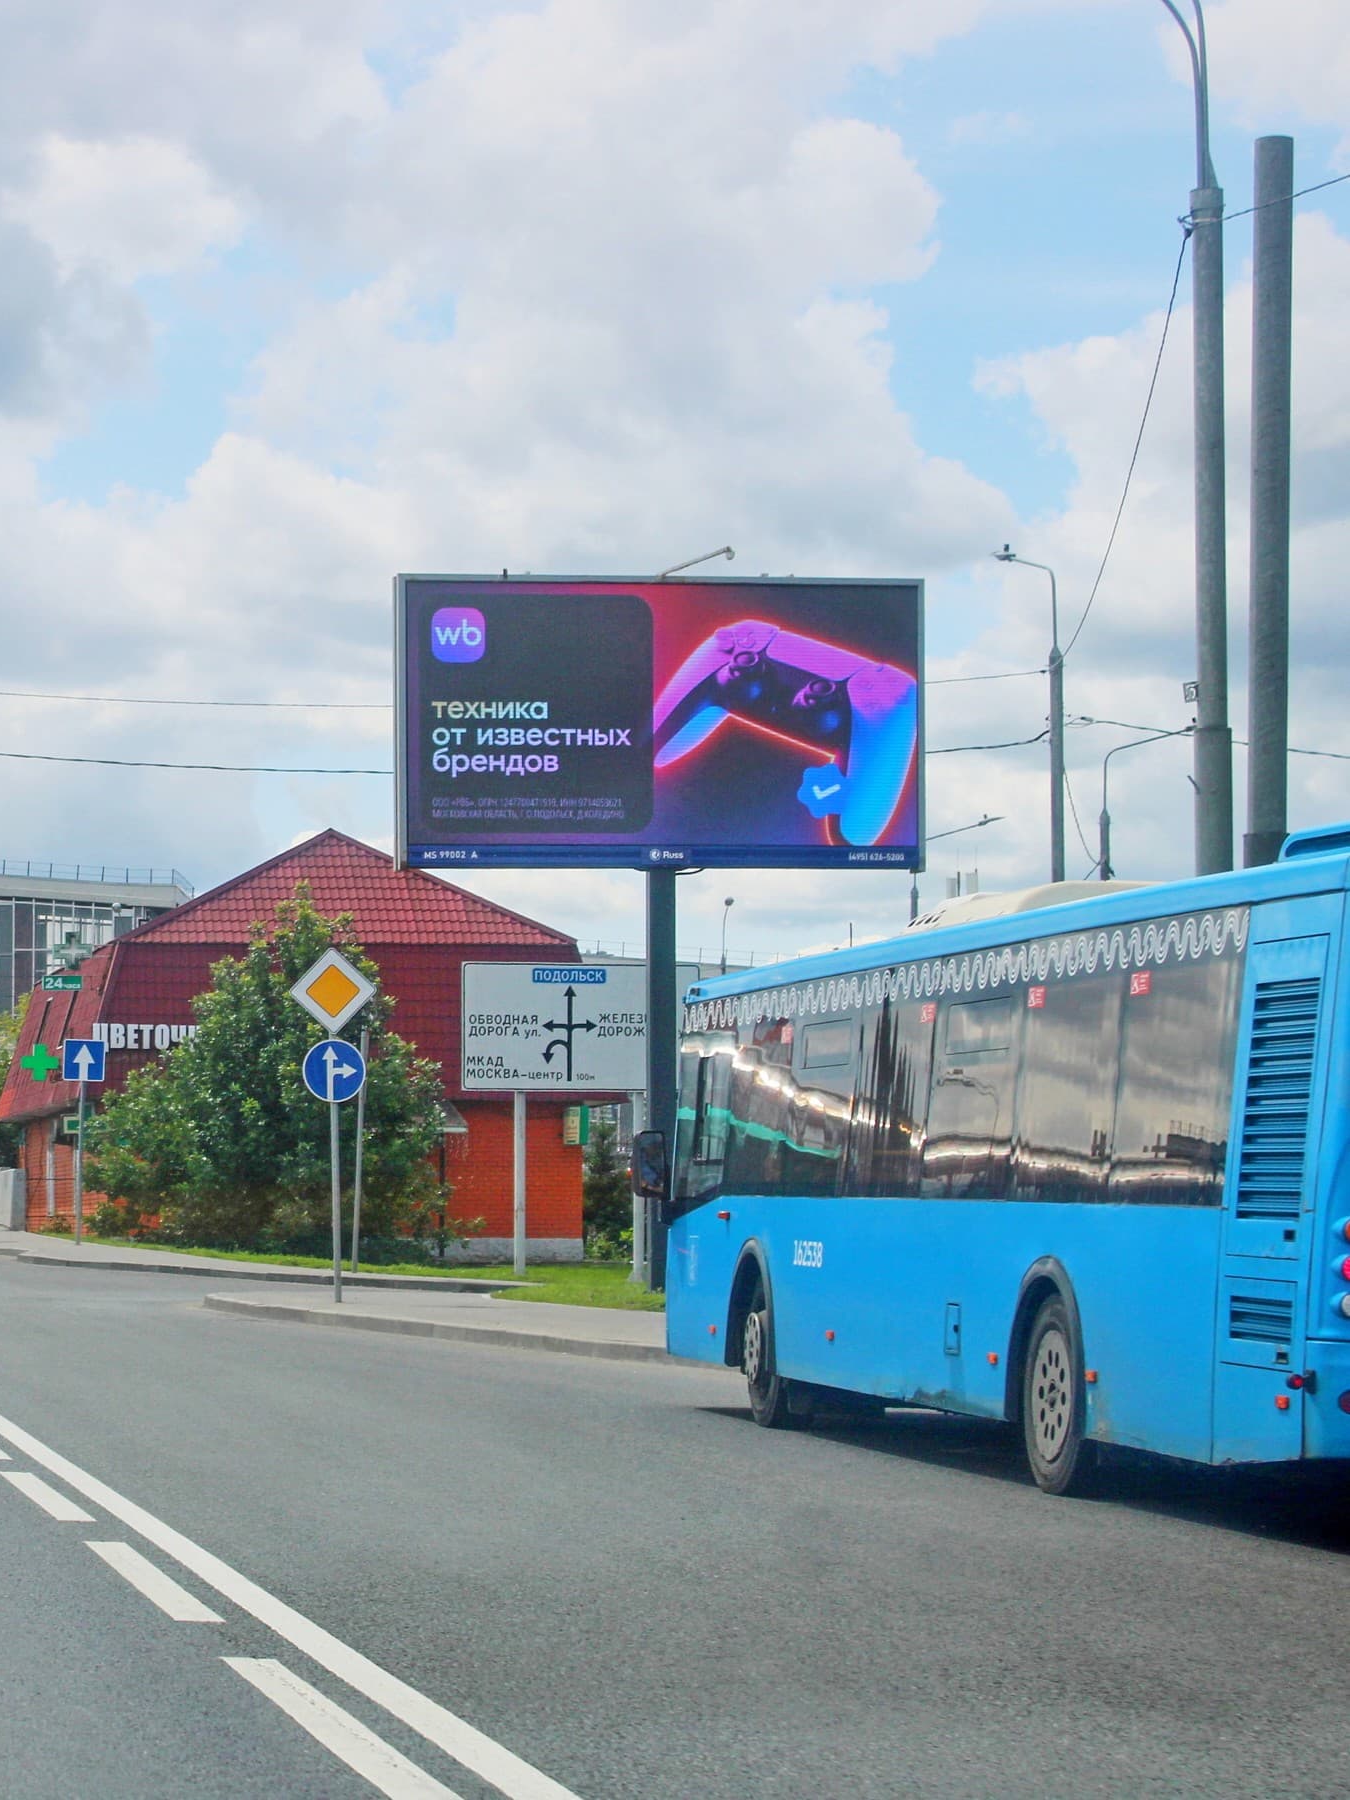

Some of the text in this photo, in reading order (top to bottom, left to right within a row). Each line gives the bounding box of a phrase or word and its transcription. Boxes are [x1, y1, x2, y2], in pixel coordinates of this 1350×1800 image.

[434, 618, 482, 646] wb
[431, 701, 548, 720] техника
[431, 727, 631, 746] от известных
[432, 747, 559, 778] брендов
[424, 851, 437, 859] MS
[439, 851, 466, 859] 99002
[662, 851, 684, 859] Russ
[534, 970, 604, 982] ПОДОЛЬСК
[44, 978, 63, 989] 24
[468, 1014, 538, 1026] ОБВОДНАЯ
[599, 1013, 647, 1024] ЖЕЛЕЗ
[468, 1026, 541, 1040] ДОРОГА ул.
[597, 1026, 646, 1038] ДОРОЖ
[466, 1056, 504, 1068] МКАД
[793, 1240, 823, 1268] 162538
